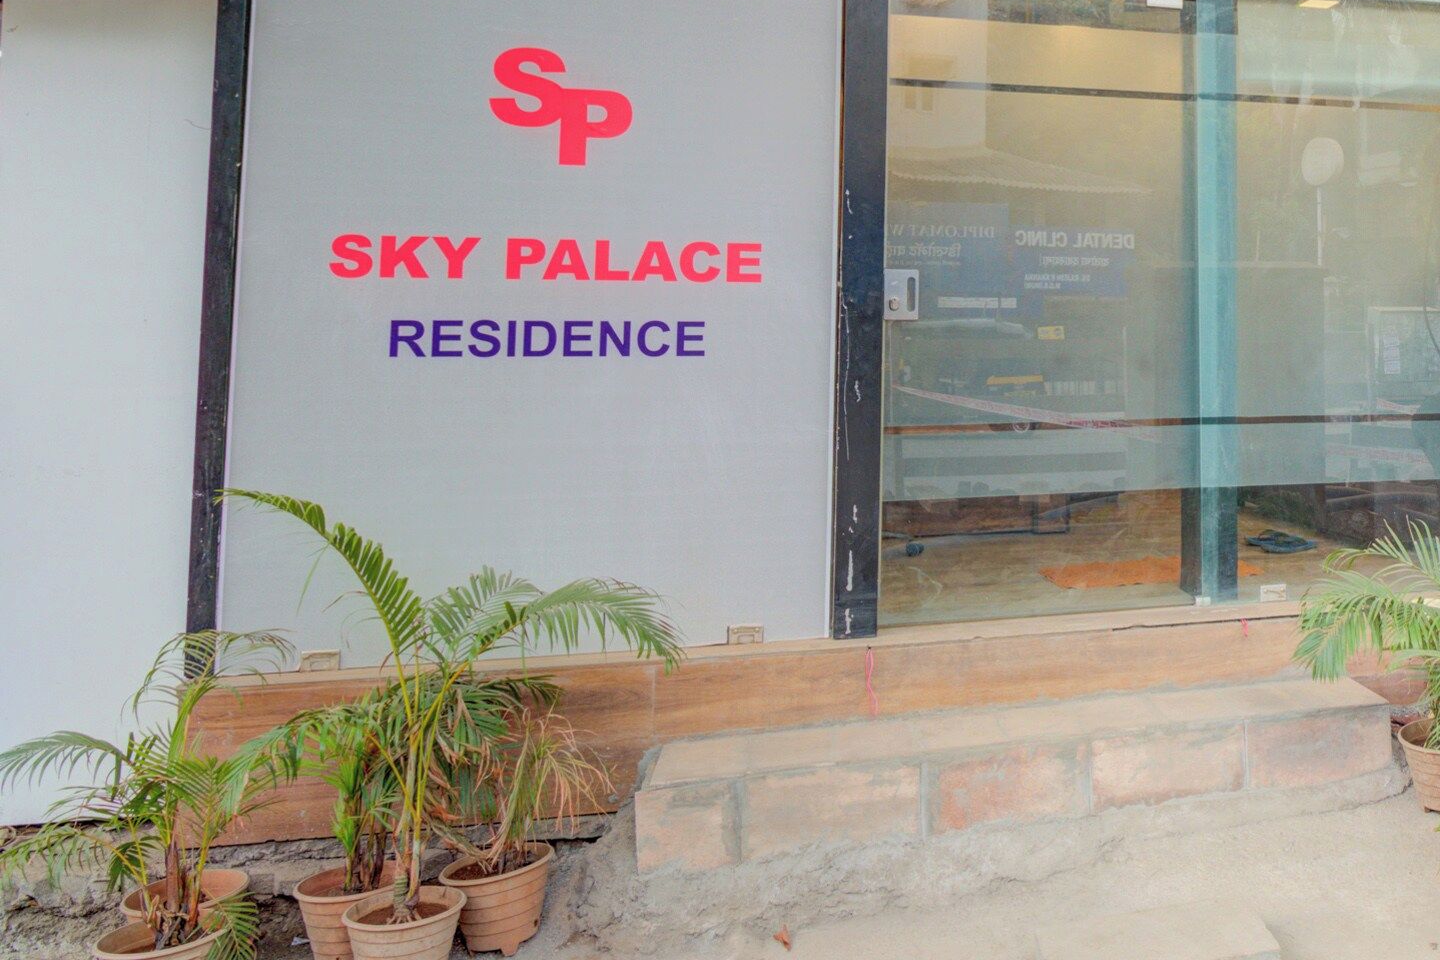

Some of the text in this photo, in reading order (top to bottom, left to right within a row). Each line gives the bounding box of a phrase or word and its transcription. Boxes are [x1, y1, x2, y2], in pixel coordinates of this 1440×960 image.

[489, 47, 633, 166] SP
[329, 234, 762, 283] SKY PALACE
[389, 320, 706, 357] RESIDENCE
